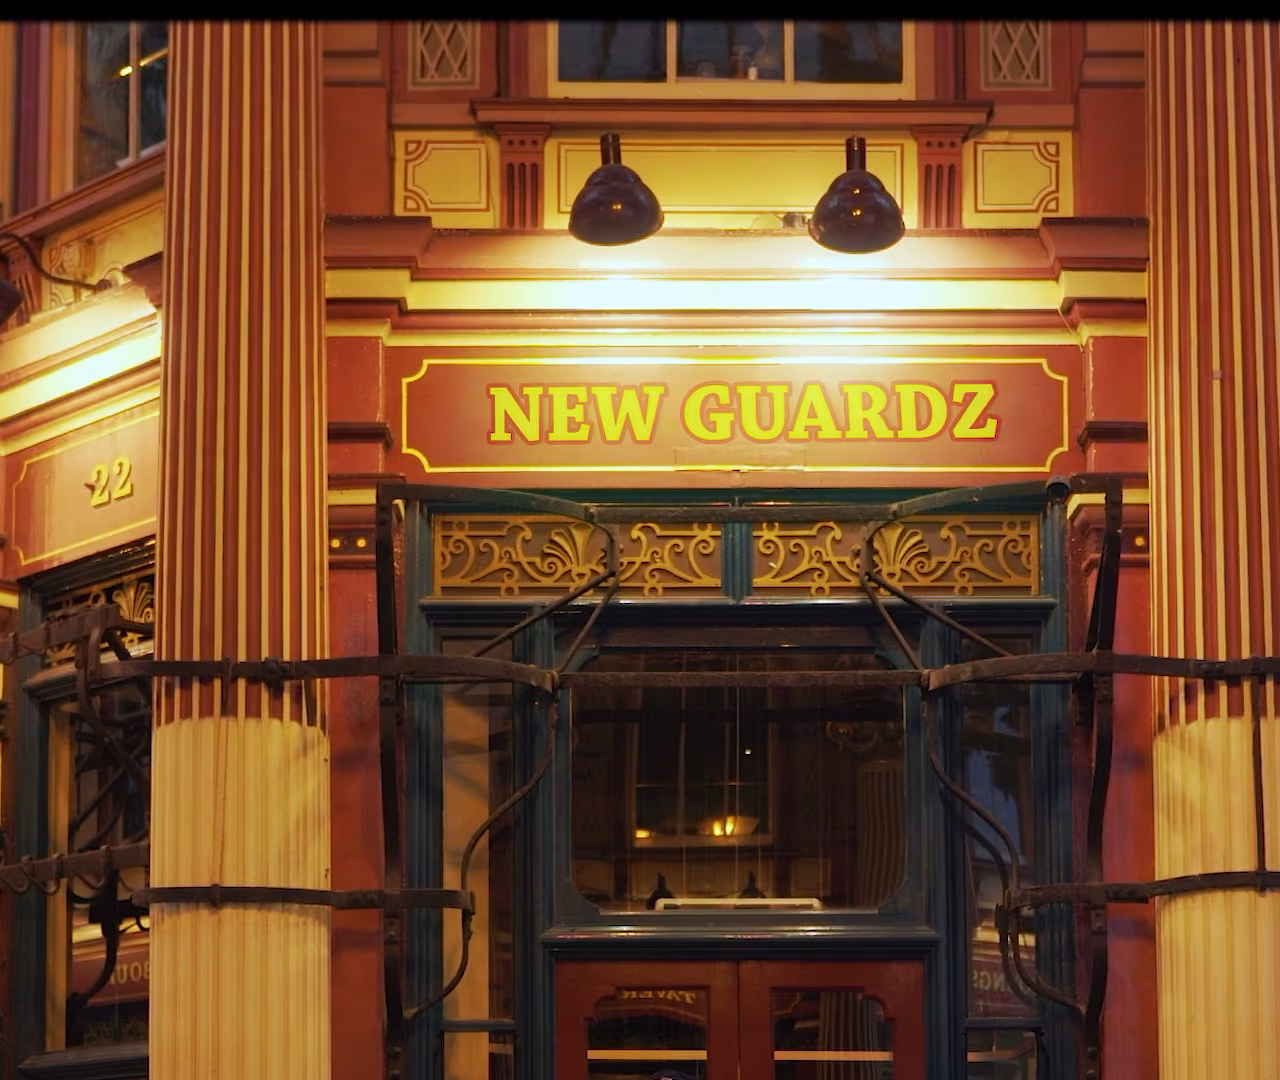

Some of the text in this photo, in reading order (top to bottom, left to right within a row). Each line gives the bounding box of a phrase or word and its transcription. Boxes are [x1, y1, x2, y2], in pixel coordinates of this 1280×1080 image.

[489, 383, 998, 442] NEW GUARDZ
[88, 456, 133, 509] 22
